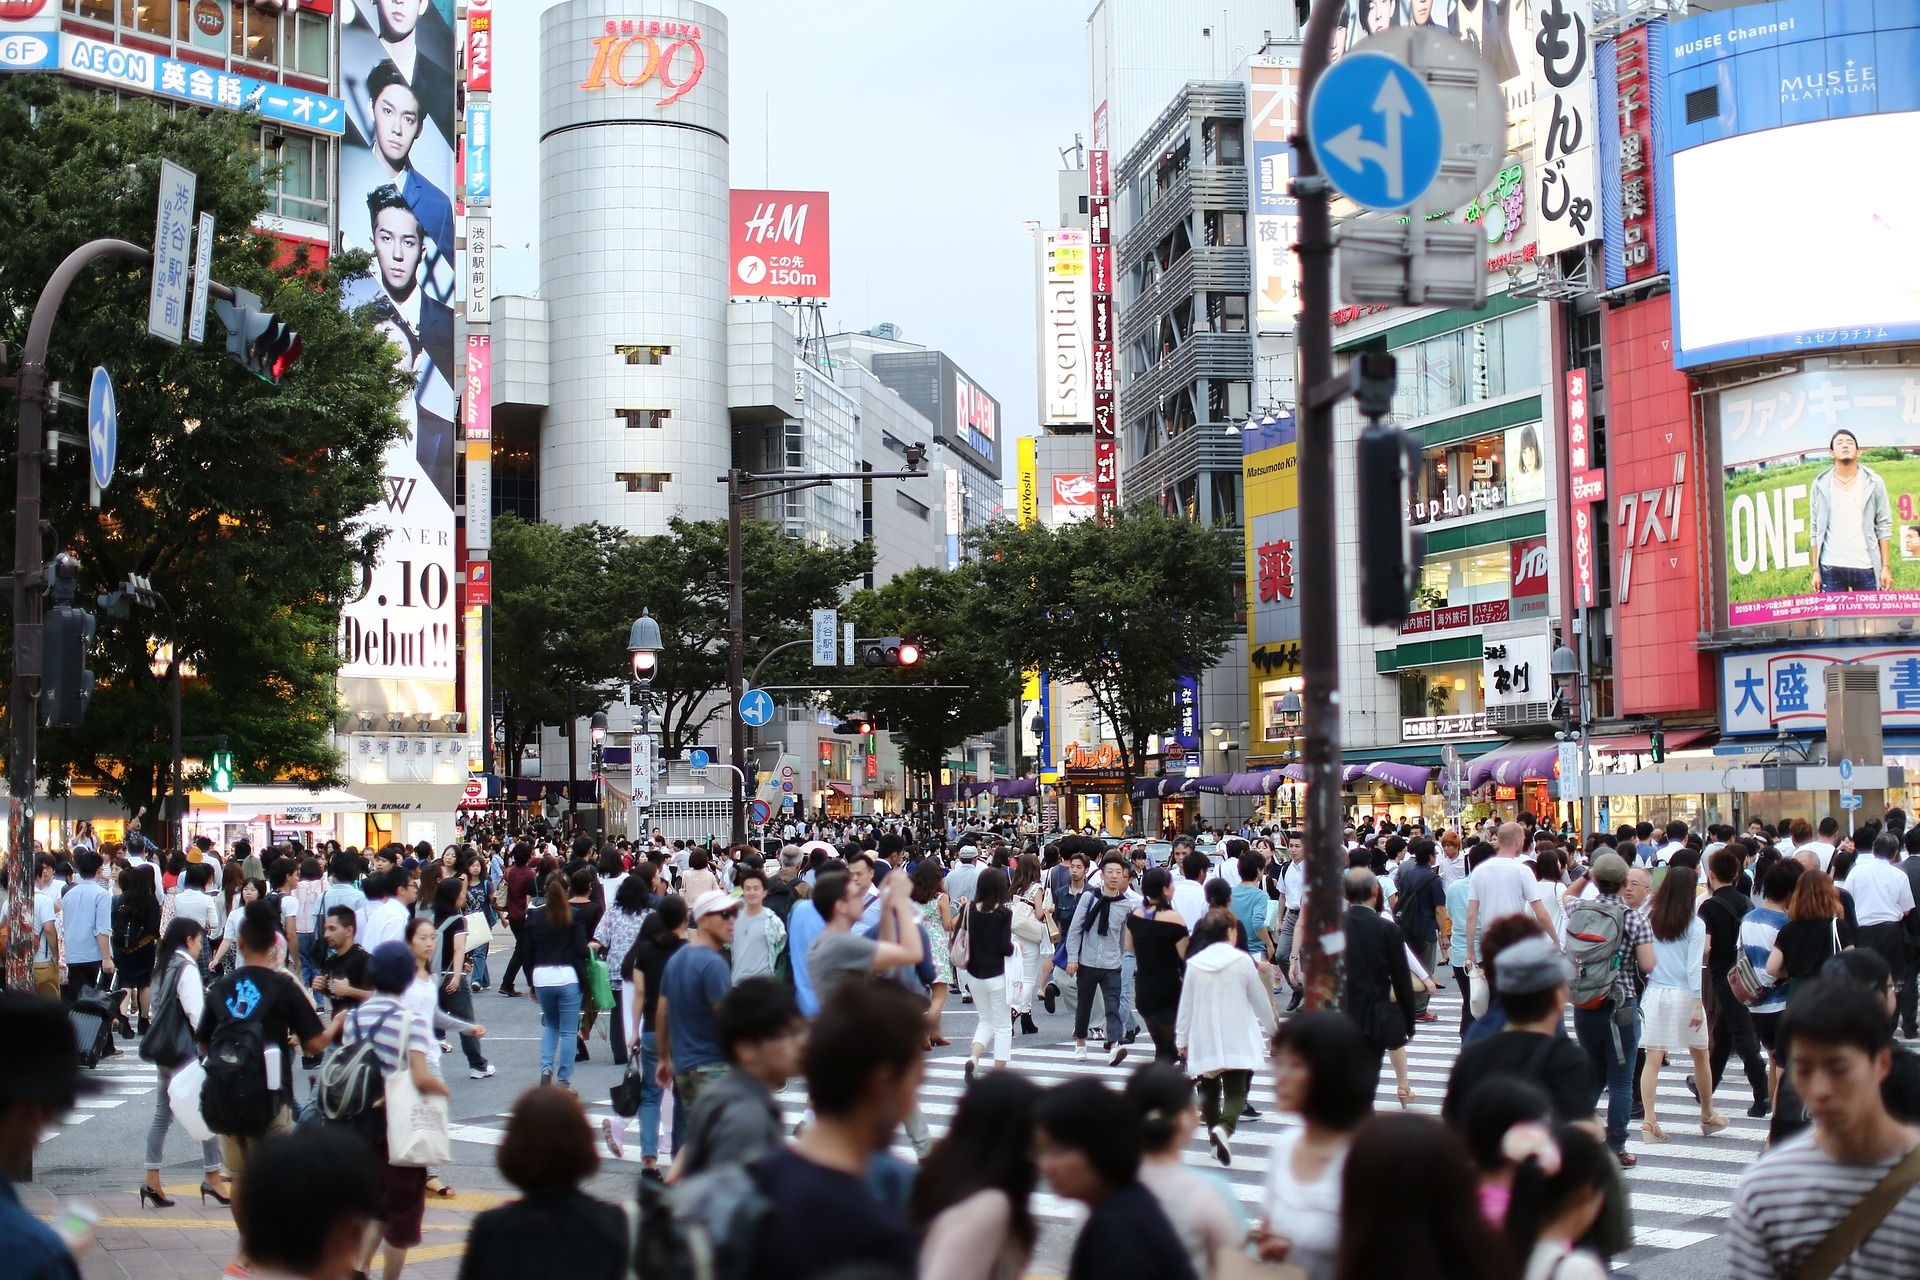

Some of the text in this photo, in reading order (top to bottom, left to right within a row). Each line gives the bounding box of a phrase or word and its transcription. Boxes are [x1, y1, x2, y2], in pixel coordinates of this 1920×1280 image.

[198, 13, 222, 27] ガスト
[604, 19, 702, 40] SHIBUYA
[1675, 18, 1795, 58] MUSEE Channel
[5, 41, 36, 60] 6F
[71, 41, 147, 83] AEON
[472, 30, 488, 79] ガスト
[579, 34, 705, 107] 109
[1781, 82, 1876, 104] PLATINUM
[1536, 7, 1593, 236] もんじゃ
[472, 112, 487, 194] 英会話イーオン
[1261, 159, 1272, 190] BOOK
[159, 199, 173, 264] Shibuya
[745, 203, 808, 245] H&M
[164, 182, 190, 328] 渋谷駅前
[472, 226, 486, 313] 渋谷駅前ビル
[769, 256, 804, 268] この先
[769, 269, 816, 286] 150m
[469, 337, 489, 347] 5F
[1051, 279, 1078, 420] Essential
[1794, 327, 1888, 346] ミュゼプラチナム
[968, 382, 995, 440] LABI
[1571, 375, 1586, 468] お好み焼
[1732, 484, 1810, 576] ONE
[1258, 539, 1294, 602] 薬
[1515, 545, 1548, 586] JTB
[1437, 609, 1468, 626] 海外旅行
[1474, 610, 1508, 624] ウエディング
[1475, 602, 1506, 614] ハネムーン
[1879, 593, 1897, 601] FOR
[345, 615, 449, 668] Debut!!
[823, 614, 833, 661] 渋谷駅前
[359, 741, 462, 754] 渋谷駅前ビル
[634, 741, 644, 800] 道玄坂
